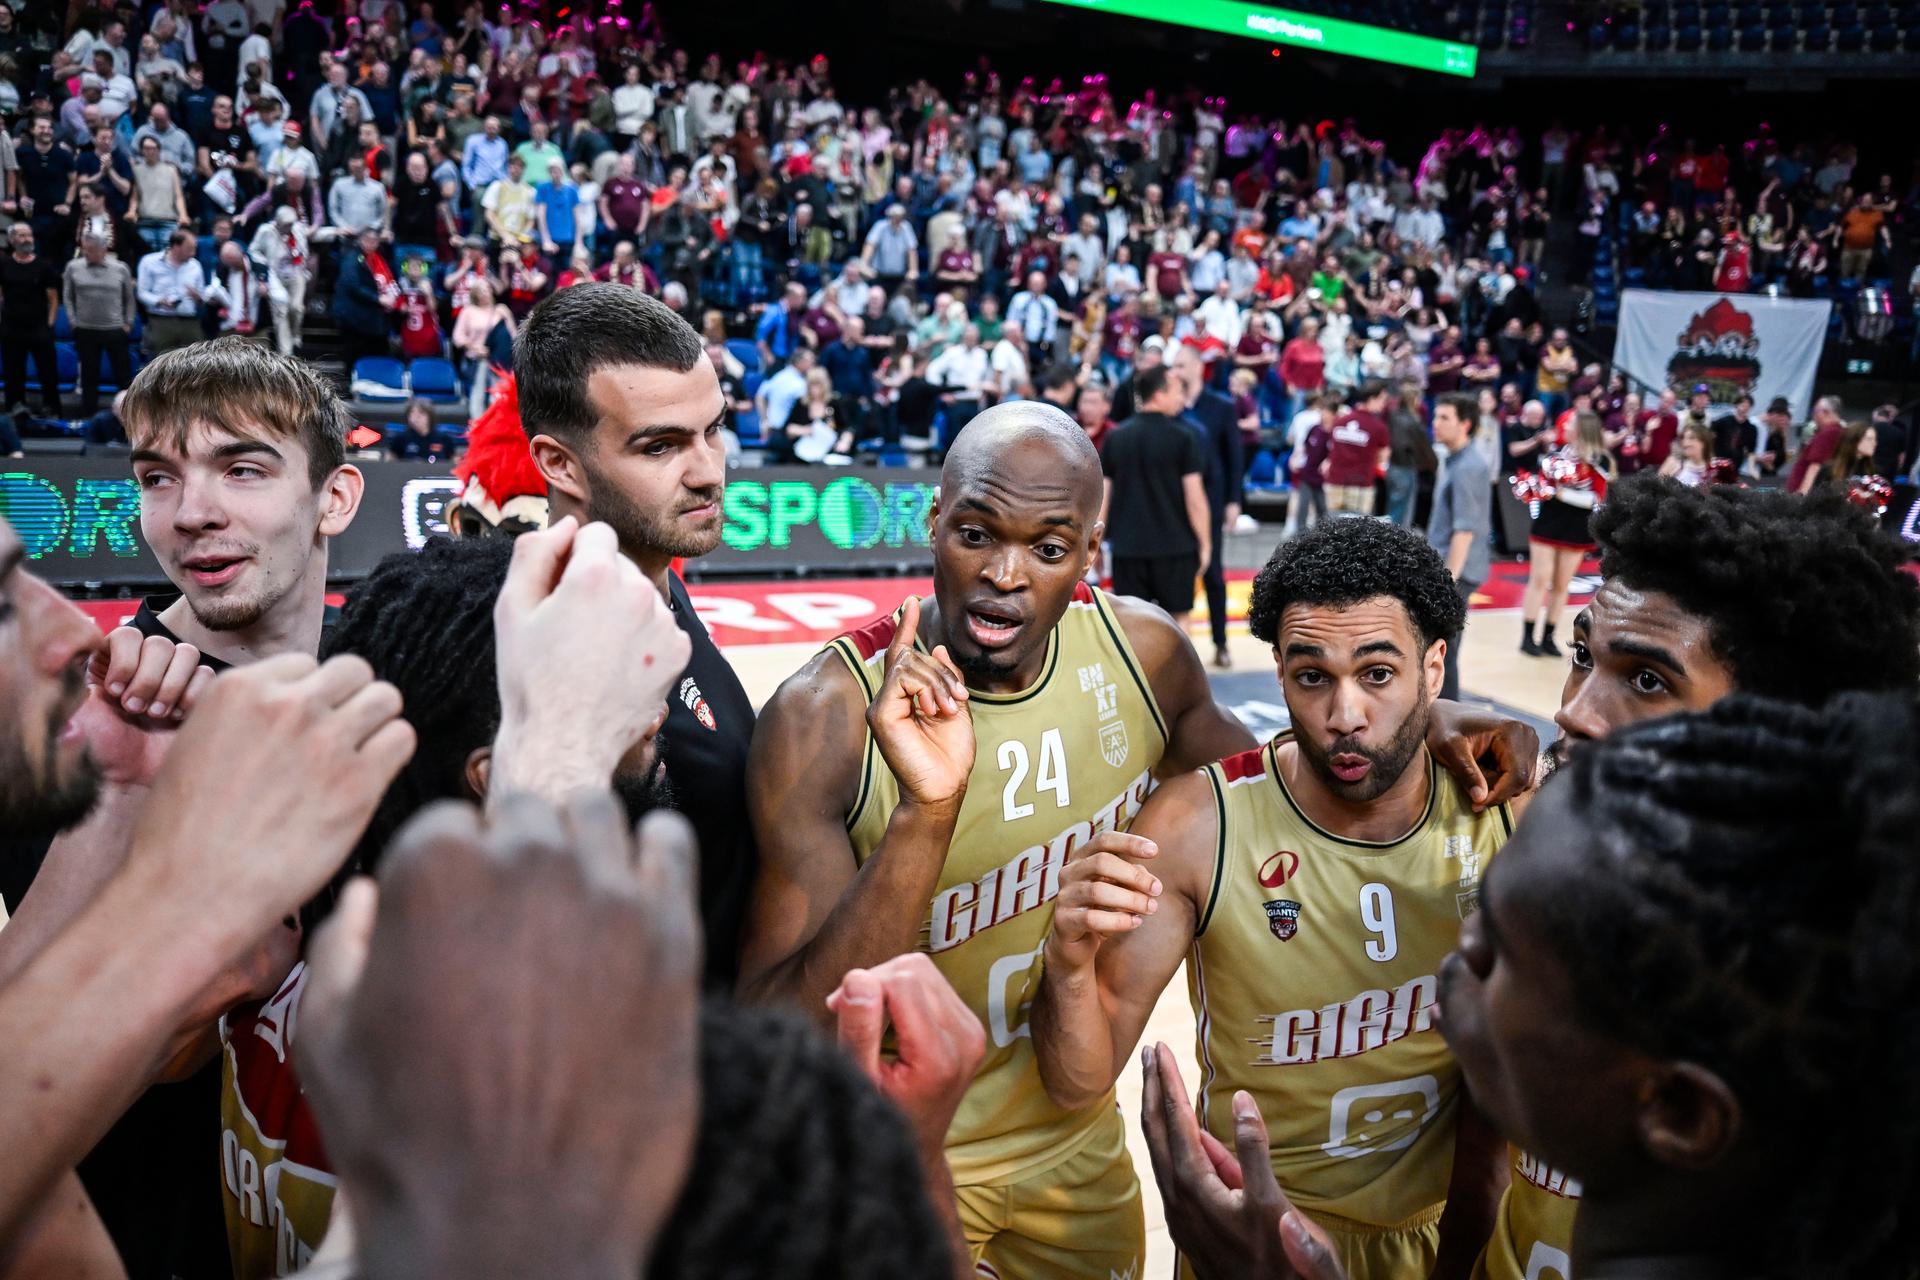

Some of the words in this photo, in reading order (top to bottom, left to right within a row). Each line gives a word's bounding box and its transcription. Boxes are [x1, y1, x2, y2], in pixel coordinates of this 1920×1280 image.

[722, 476, 940, 551] SPOR
[996, 727, 1070, 822] 24
[1267, 908, 1298, 918] GIANTS
[1359, 882, 1398, 962] 9
